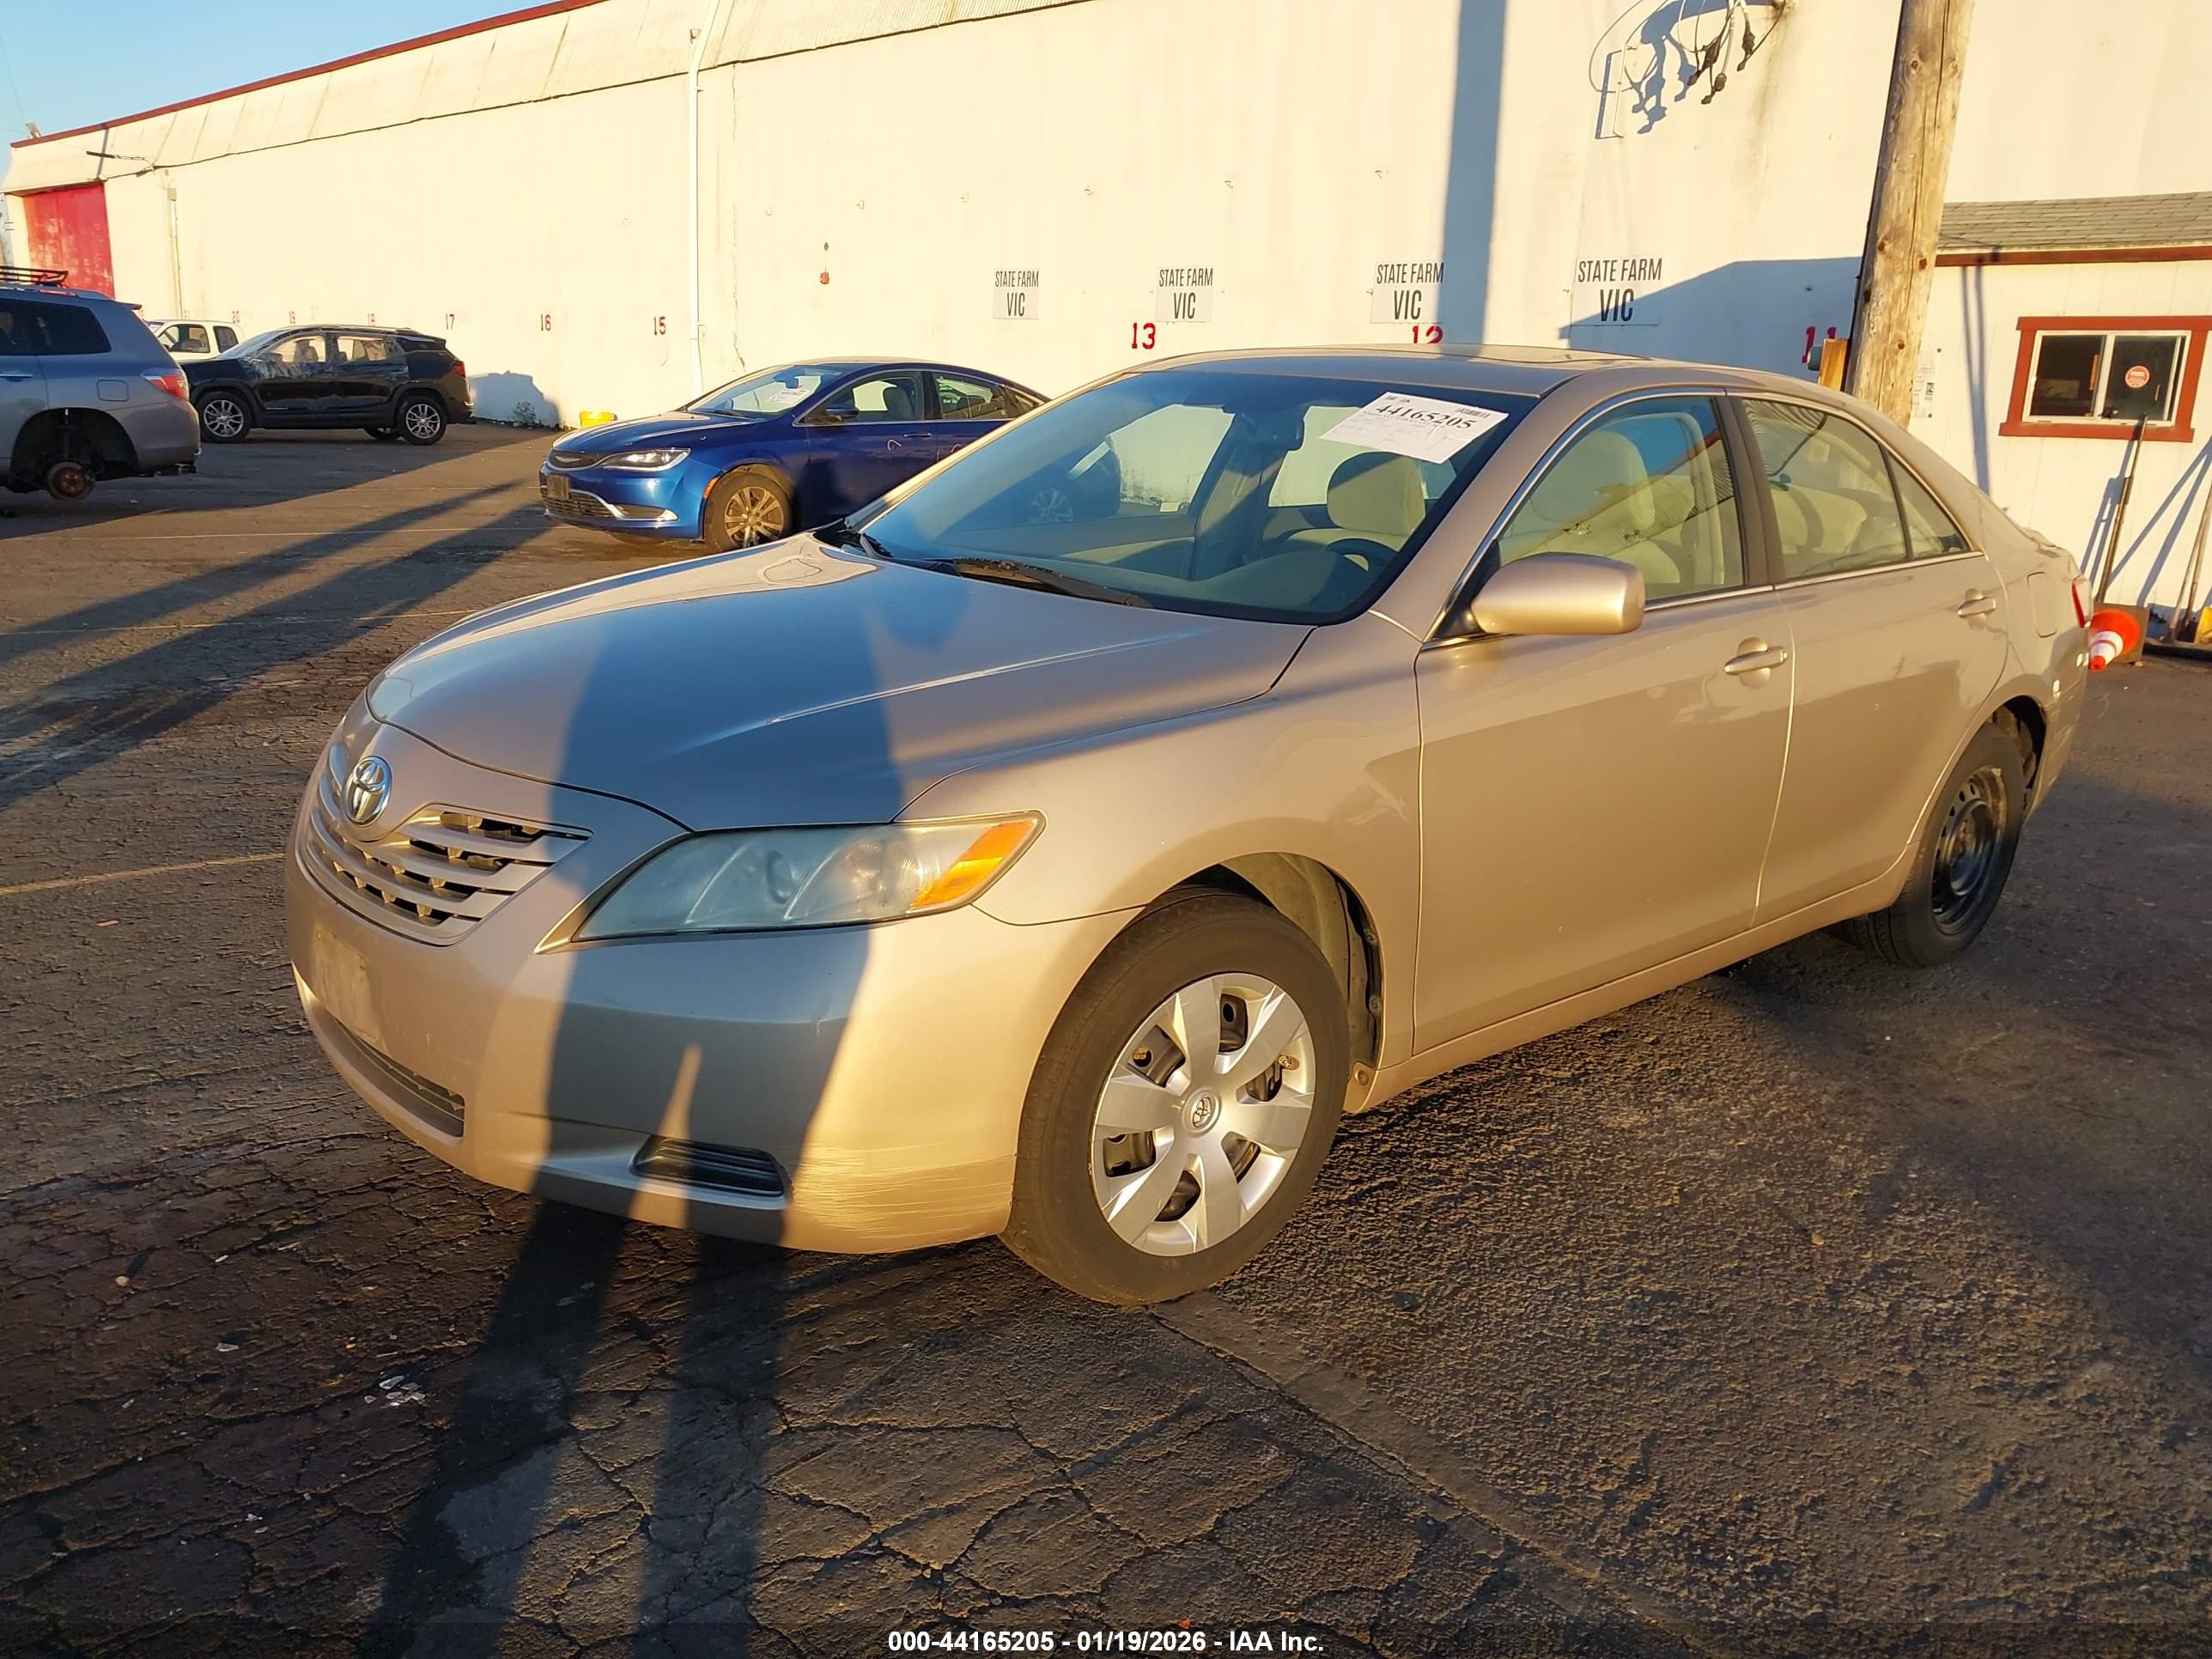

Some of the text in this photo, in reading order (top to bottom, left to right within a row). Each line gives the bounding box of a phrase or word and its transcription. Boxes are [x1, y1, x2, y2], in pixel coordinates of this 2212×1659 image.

[994, 270, 1039, 288] STATE FARM
[1158, 267, 1213, 288] STATE FARM
[1376, 262, 1444, 285] STATE FARM
[1577, 258, 1662, 283] STATE FARM
[1006, 292, 1025, 318] VIC
[1173, 292, 1196, 319] VIC
[1394, 289, 1422, 320] VIC
[1600, 288, 1635, 323] VIC
[445, 313, 455, 331] 17
[540, 313, 552, 331] 16
[653, 316, 667, 336] 15
[1132, 322, 1157, 350] 13
[1413, 325, 1443, 344] 12
[1376, 404, 1478, 430] 44165205
